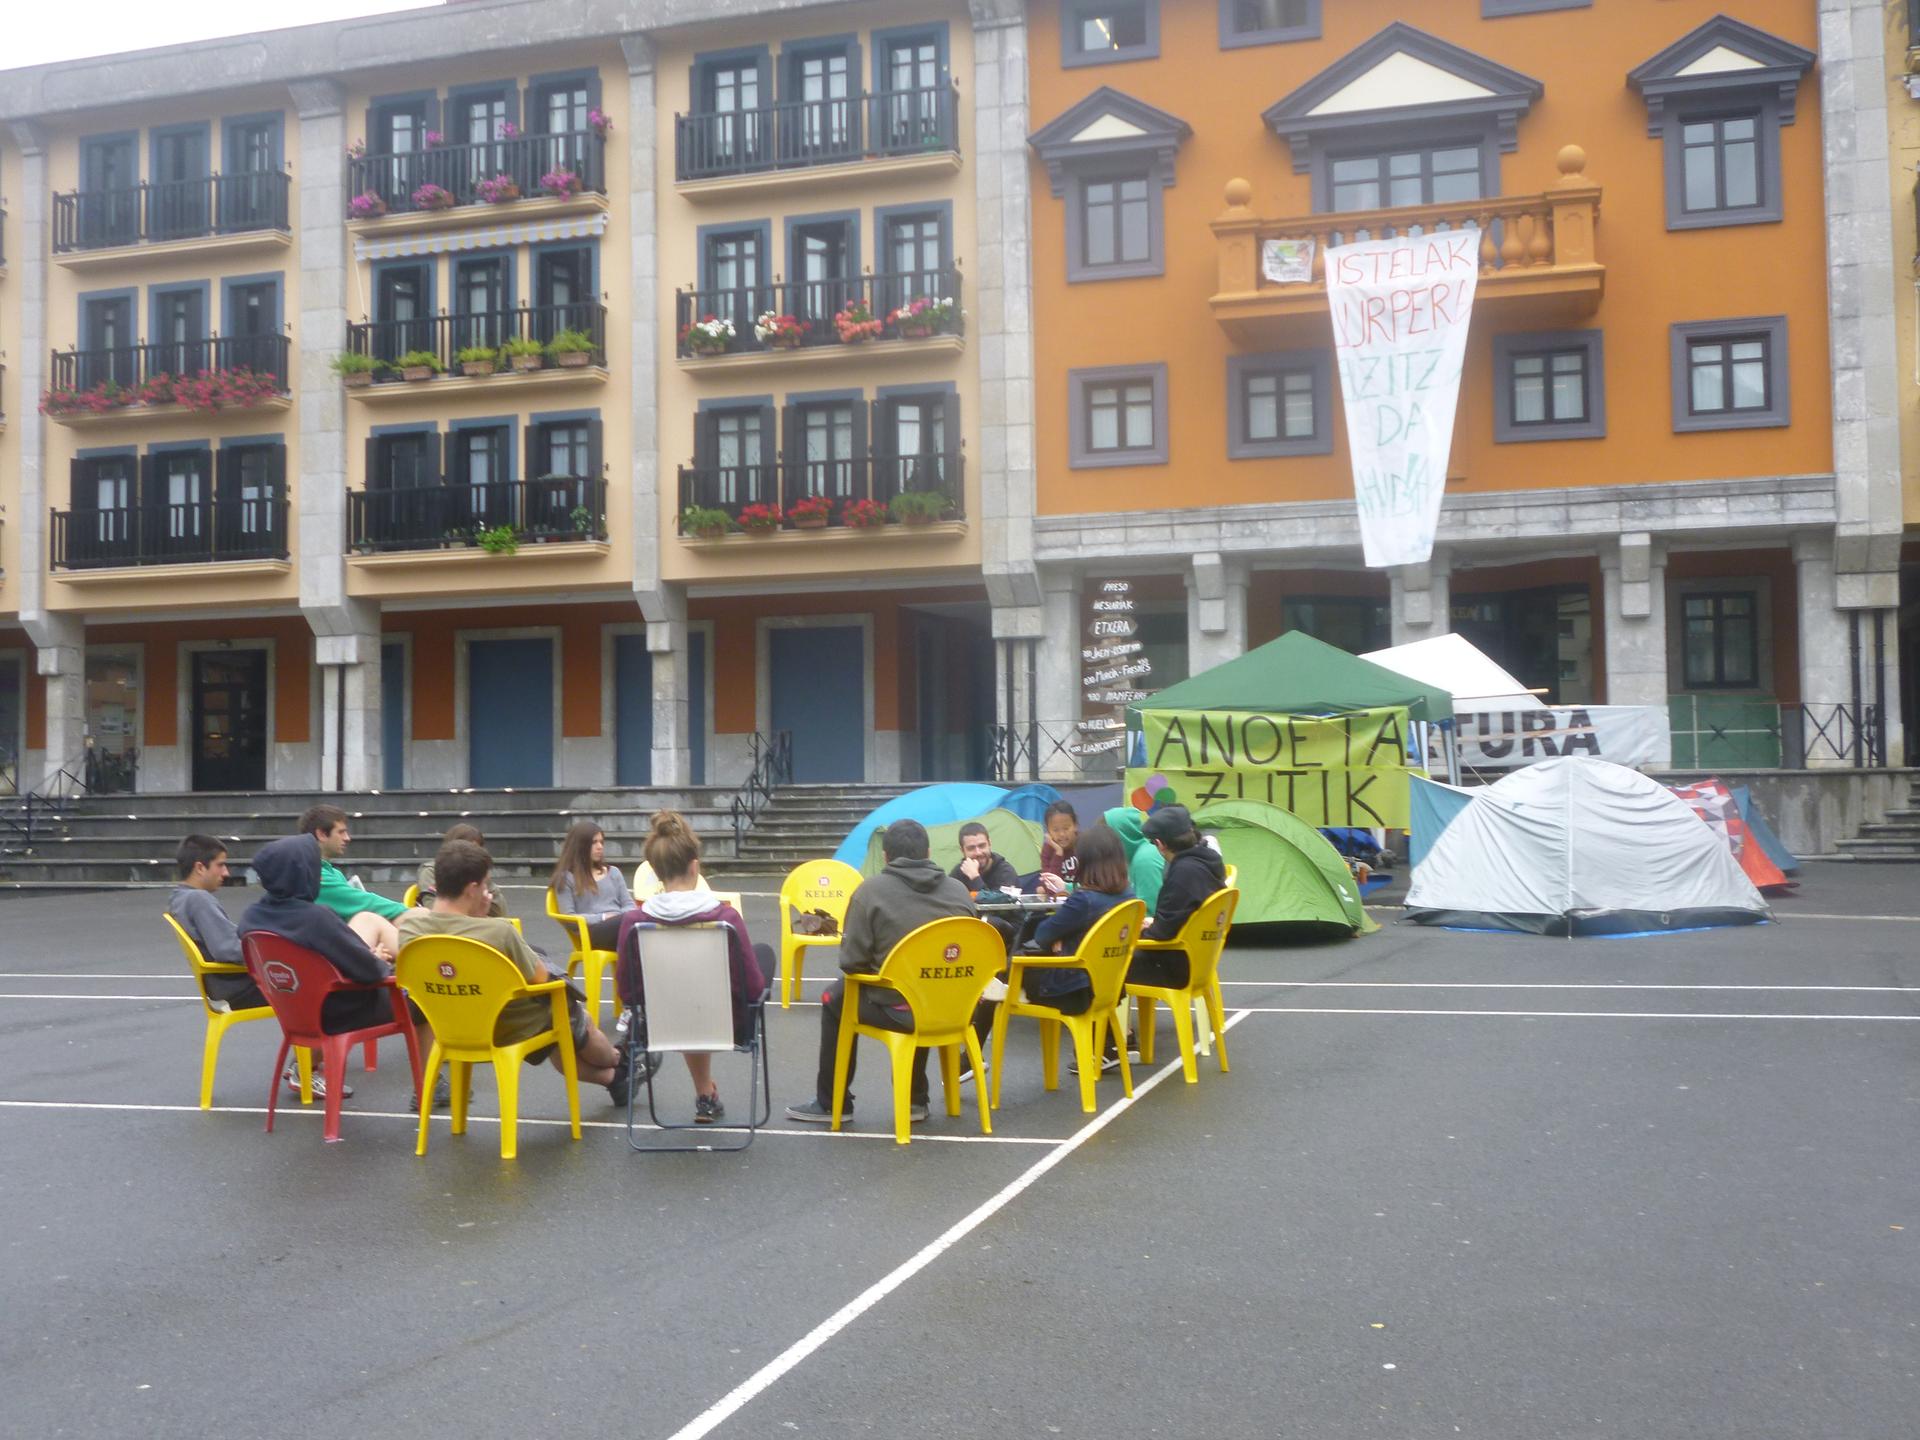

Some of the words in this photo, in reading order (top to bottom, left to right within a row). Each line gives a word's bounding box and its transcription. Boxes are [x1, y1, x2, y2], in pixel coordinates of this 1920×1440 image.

[1336, 237, 1472, 284] ISTELAK
[1377, 402, 1421, 446] DA
[1103, 582, 1129, 591] PRESO
[1094, 620, 1131, 634] ETXERA
[1154, 712, 1406, 768] ANOETA
[805, 890, 844, 898] KELER
[919, 966, 975, 979] KELER
[424, 981, 483, 997] KELER
